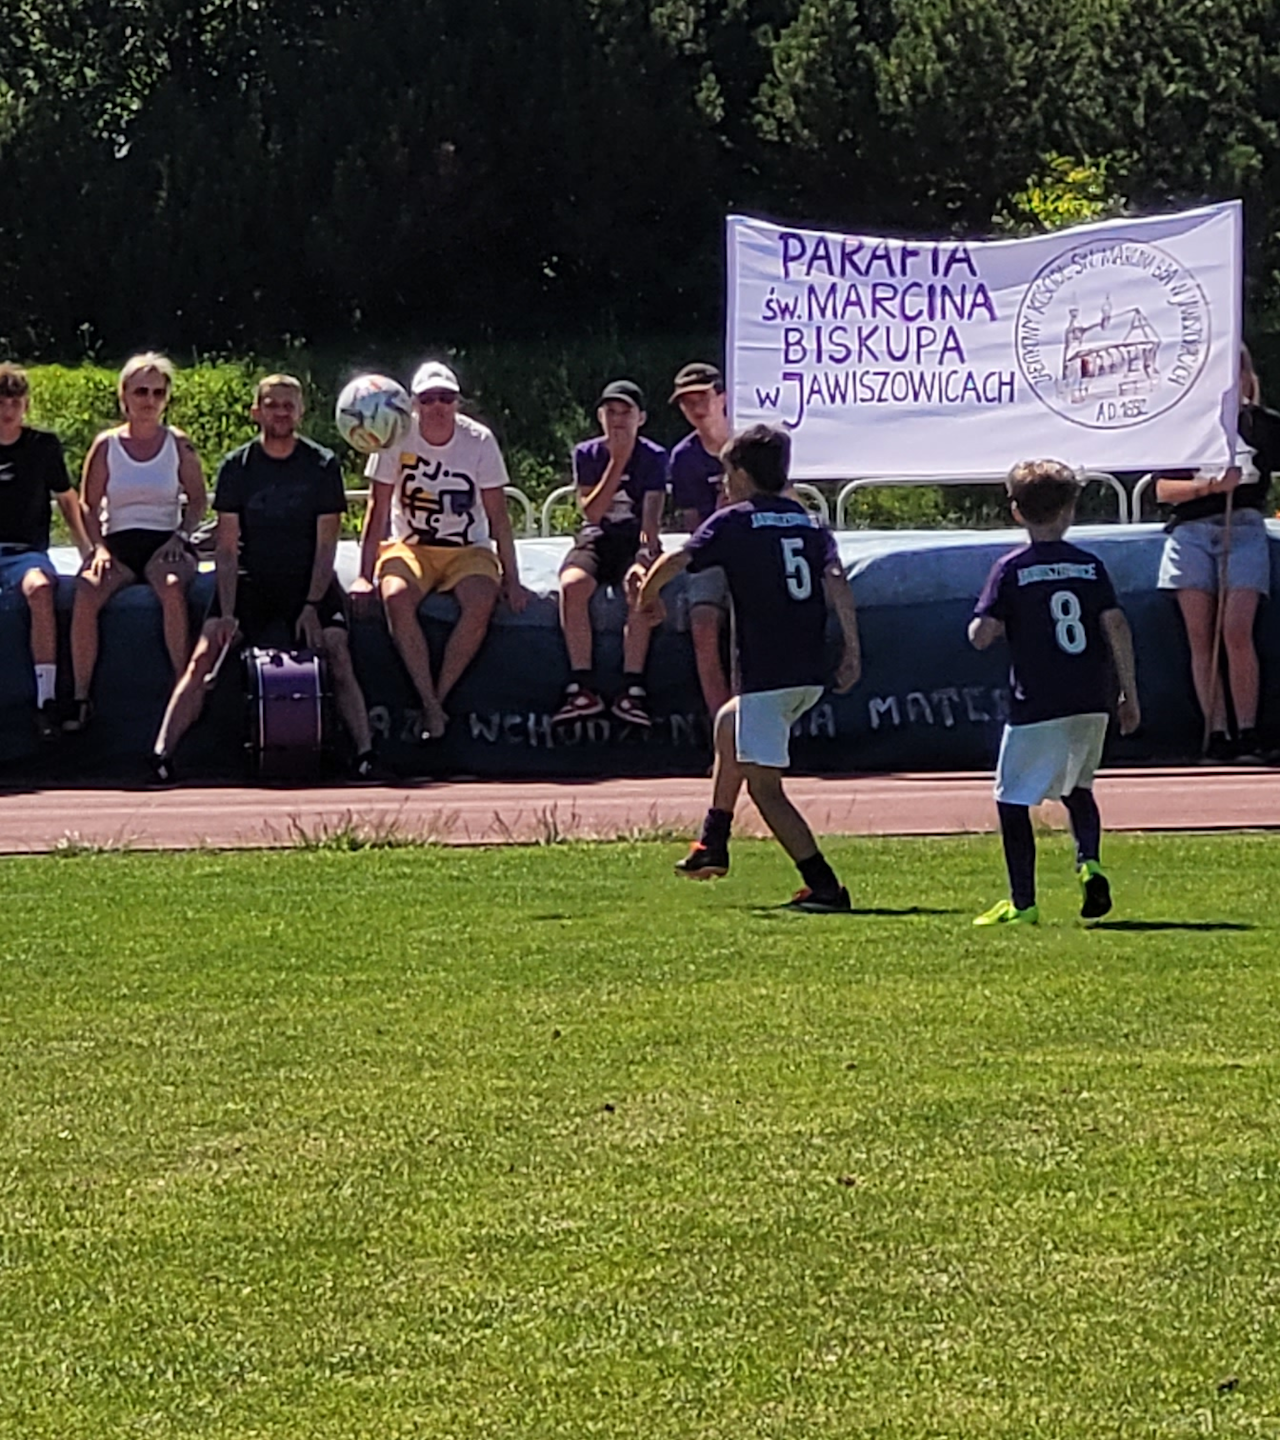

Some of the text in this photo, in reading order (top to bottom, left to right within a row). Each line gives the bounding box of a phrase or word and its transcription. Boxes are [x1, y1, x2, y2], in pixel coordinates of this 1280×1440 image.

[778, 232, 978, 280] PARAFIA
[761, 281, 998, 322] św. MARCINA
[783, 324, 966, 365] BISKUPA
[755, 370, 1016, 430] w JAWISZOWICACH
[781, 537, 812, 601] 5
[1050, 590, 1087, 655] 8
